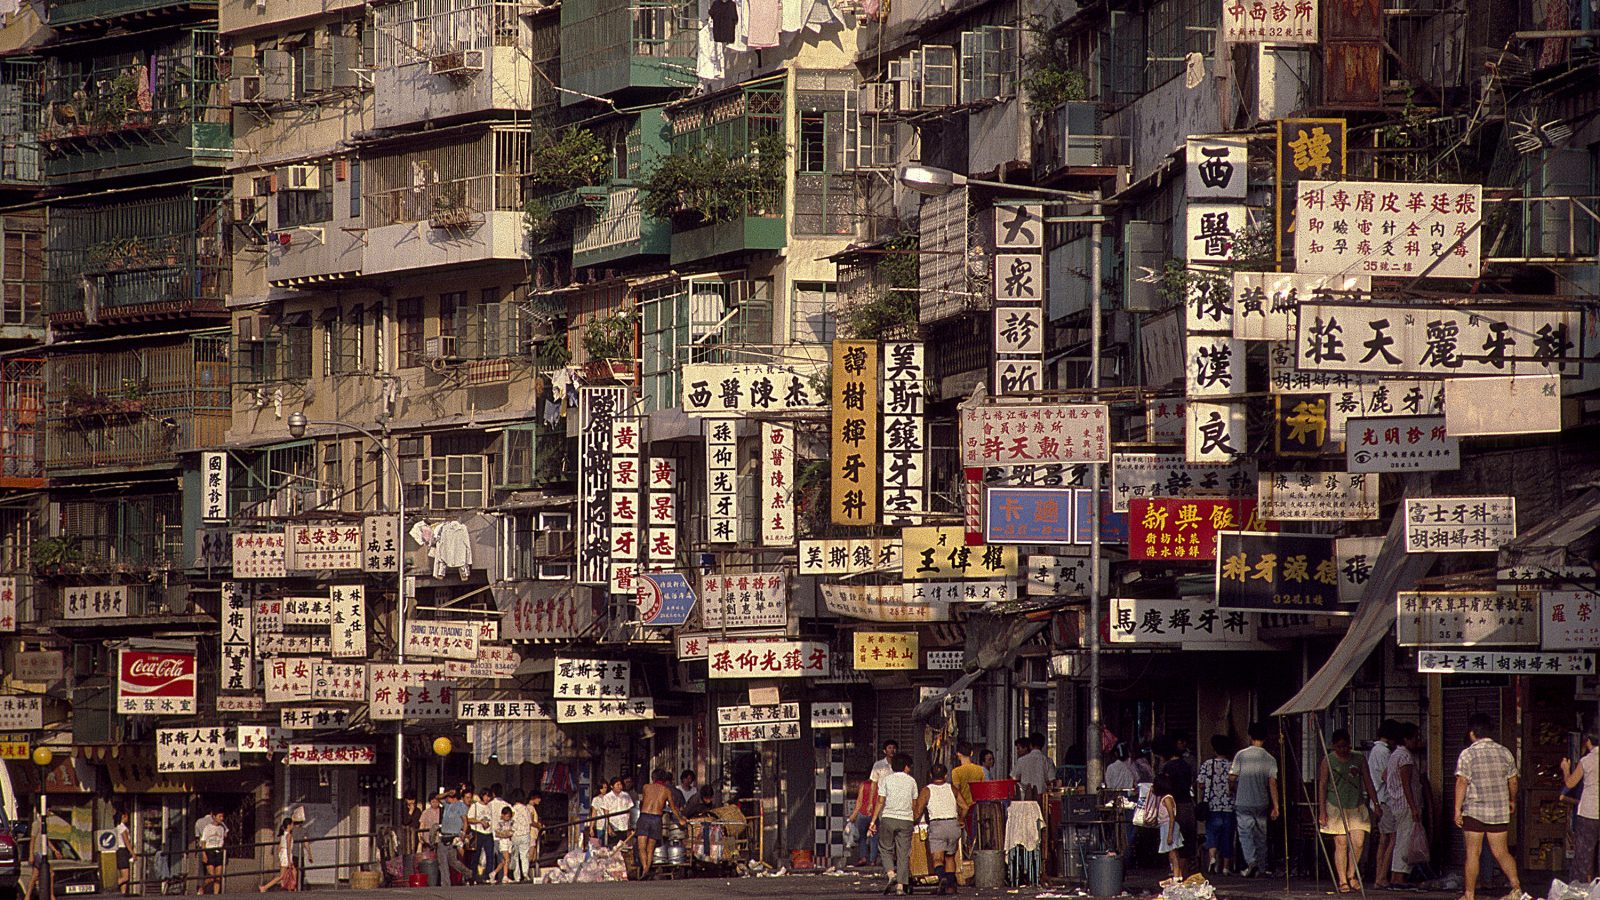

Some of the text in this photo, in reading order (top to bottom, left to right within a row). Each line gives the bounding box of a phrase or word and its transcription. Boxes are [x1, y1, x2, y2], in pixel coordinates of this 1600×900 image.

[1228, 1, 1313, 23] 中西診所
[842, 347, 867, 519] 譚樹輝牙科
[713, 423, 734, 541] 孫仰光牙科
[769, 428, 785, 531] 西醫陳杰生
[651, 462, 675, 573] 黃景志
[1409, 502, 1491, 523] 富士牙科
[1410, 528, 1490, 548] 胡湘婦科
[130, 658, 184, 678] Coca-Cola
[712, 648, 827, 673] 孫仰光鑲牙
[1424, 655, 1487, 670] 富士牙科
[1497, 655, 1562, 671] 胡湘婦科
[124, 698, 192, 711] 松發冰室
